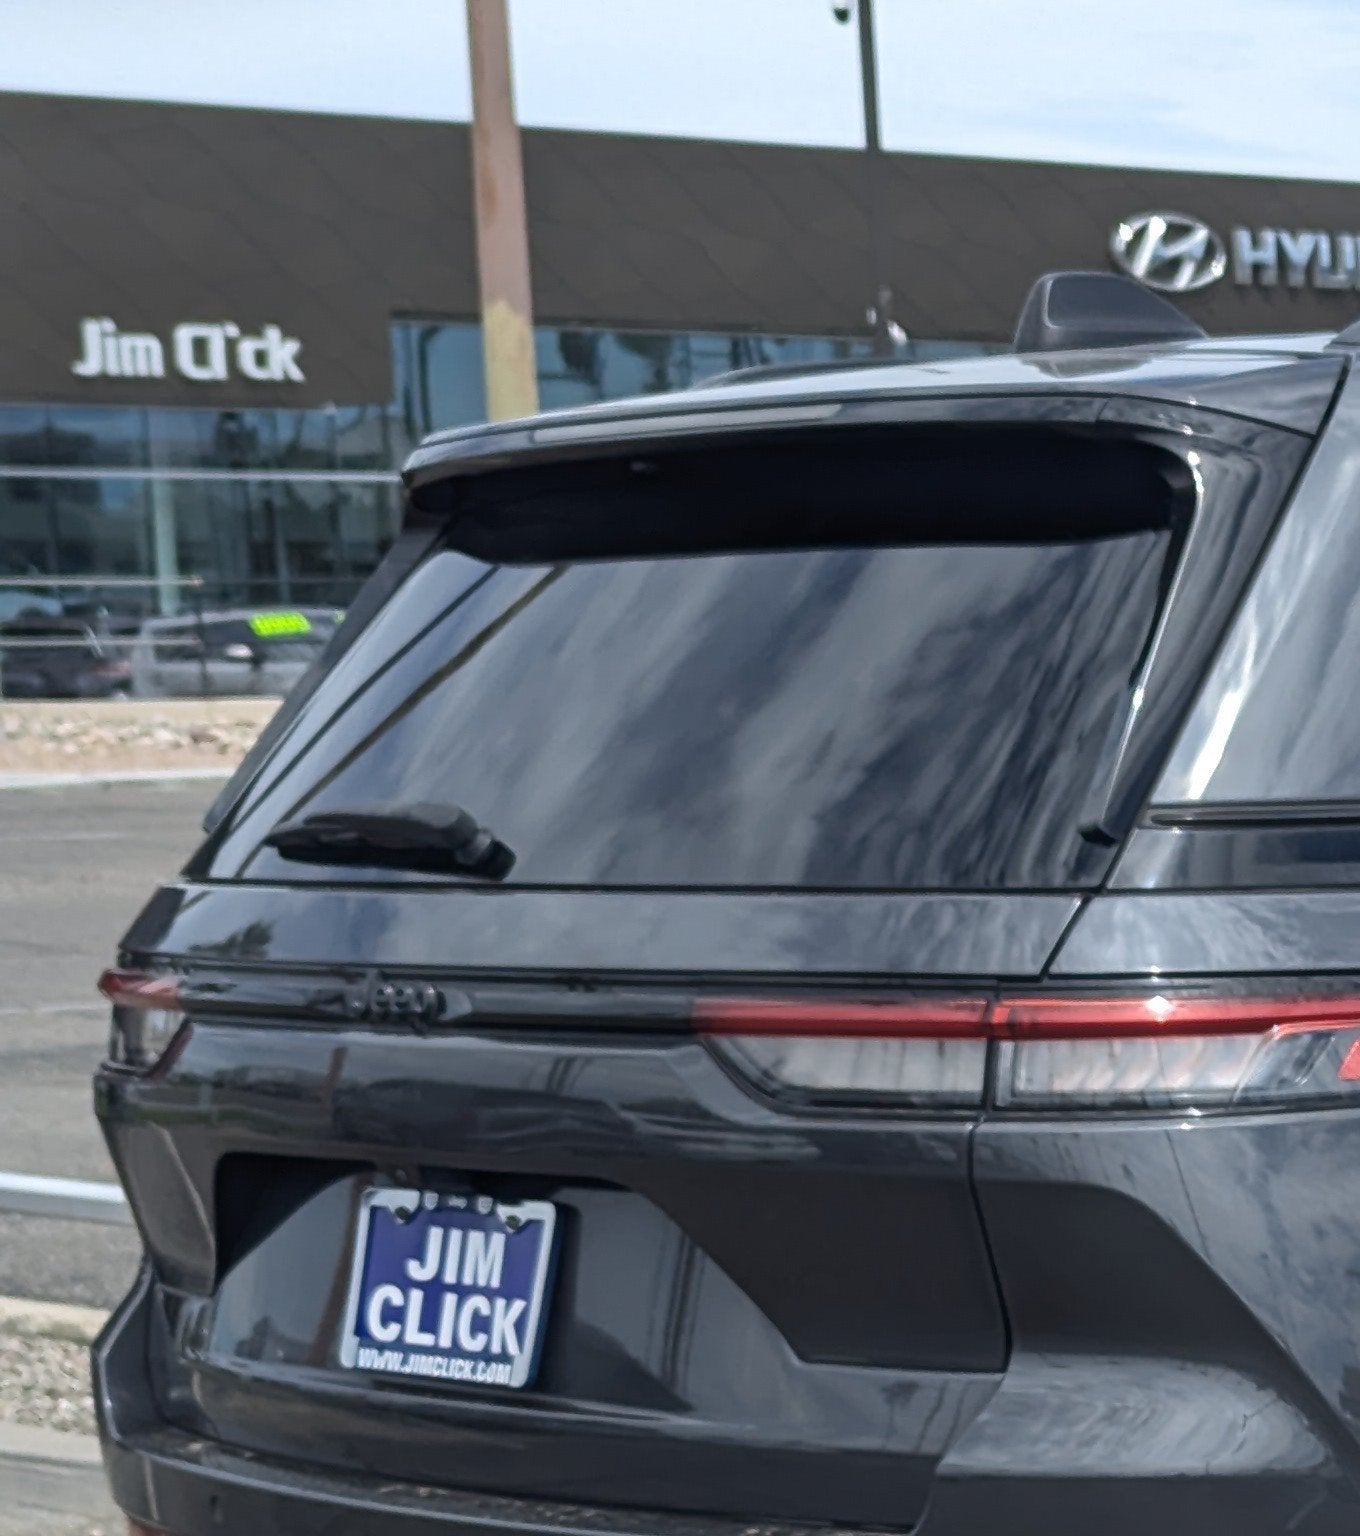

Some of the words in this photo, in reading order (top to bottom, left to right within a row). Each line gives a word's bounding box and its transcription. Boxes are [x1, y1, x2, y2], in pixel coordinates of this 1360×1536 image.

[71, 316, 166, 379] Jim
[406, 1225, 506, 1290] JIM
[366, 1283, 528, 1357] CLICK
